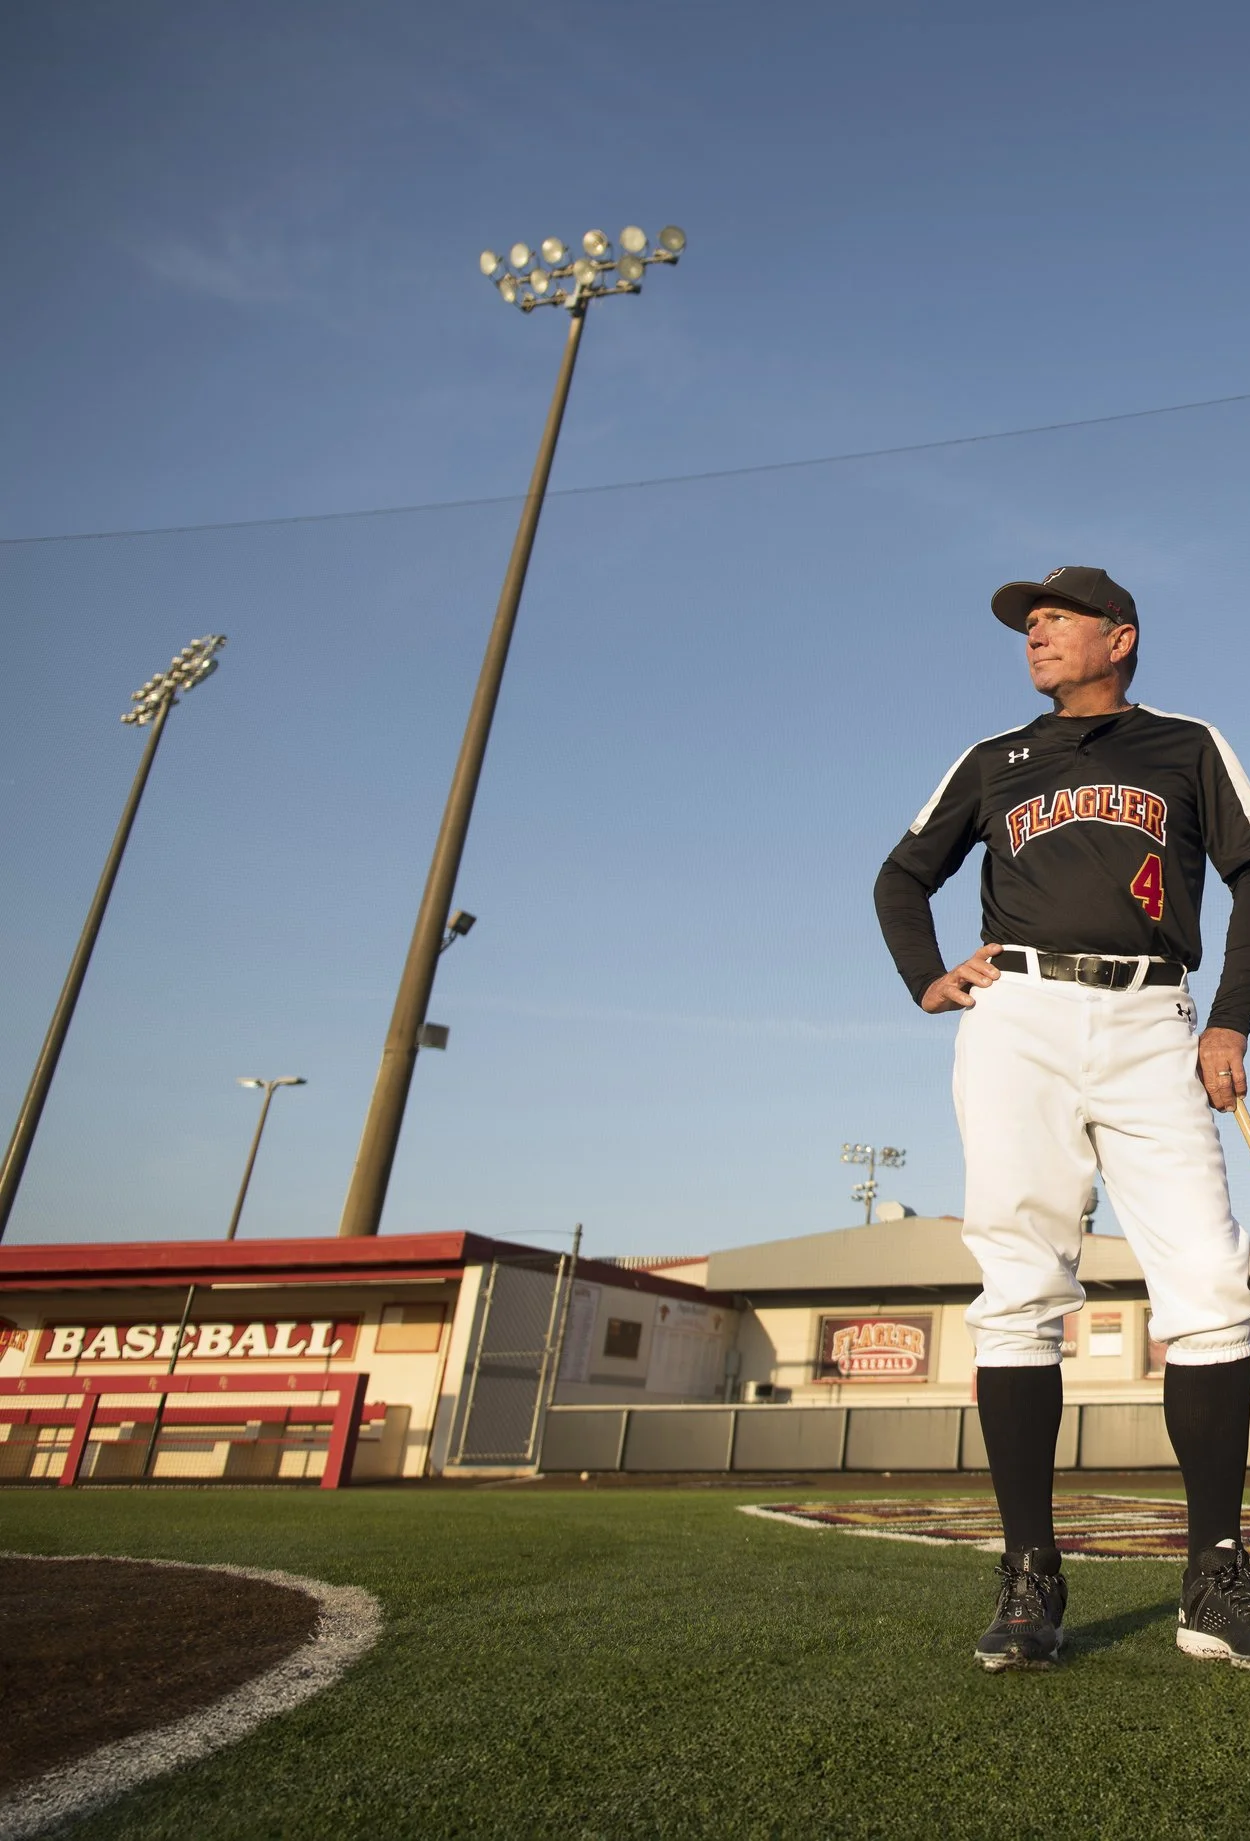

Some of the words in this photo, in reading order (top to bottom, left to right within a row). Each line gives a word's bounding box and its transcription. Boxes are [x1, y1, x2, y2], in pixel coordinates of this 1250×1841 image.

[1006, 784, 1167, 857] FLAGLER
[1130, 853, 1164, 921] 4
[45, 1322, 342, 1360] BASEBALL
[832, 1323, 924, 1360] FLAGLER
